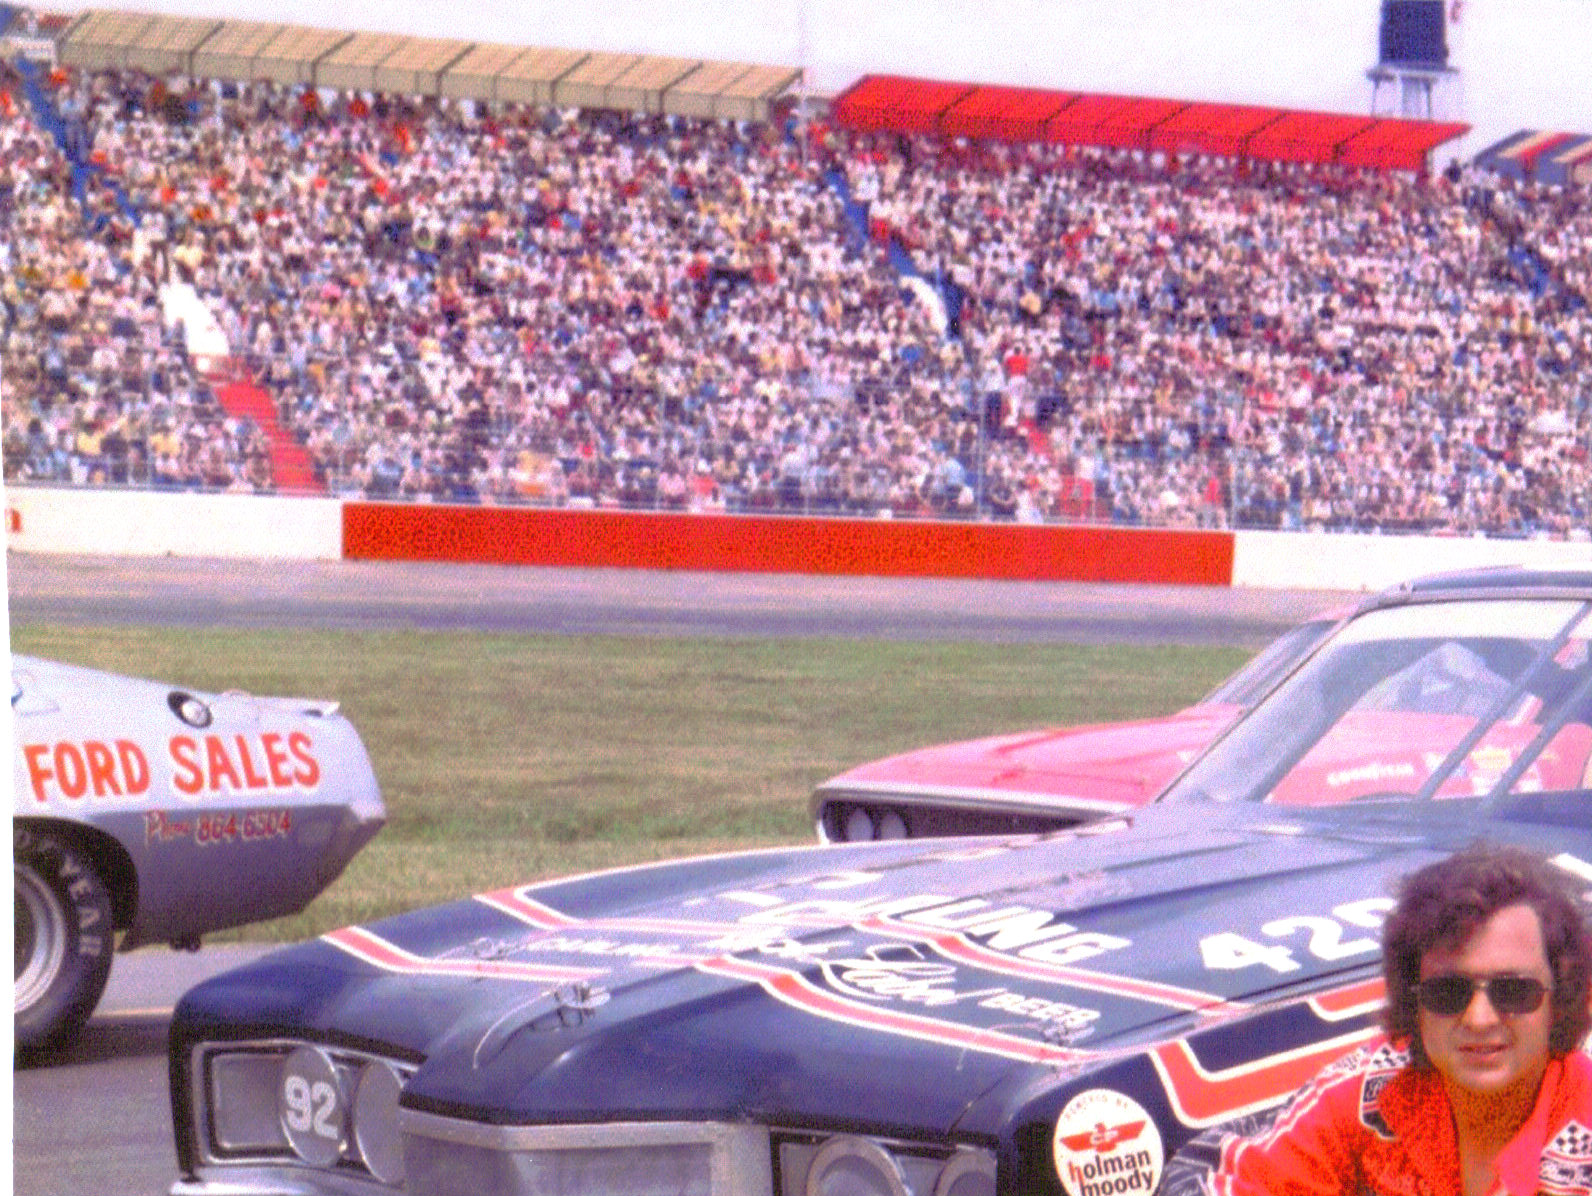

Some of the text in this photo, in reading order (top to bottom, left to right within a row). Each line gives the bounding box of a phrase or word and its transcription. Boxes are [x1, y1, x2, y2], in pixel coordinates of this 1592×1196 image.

[23, 732, 321, 801] FORD SALES
[284, 1075, 339, 1140] 92
[1068, 1149, 1152, 1183] holman
